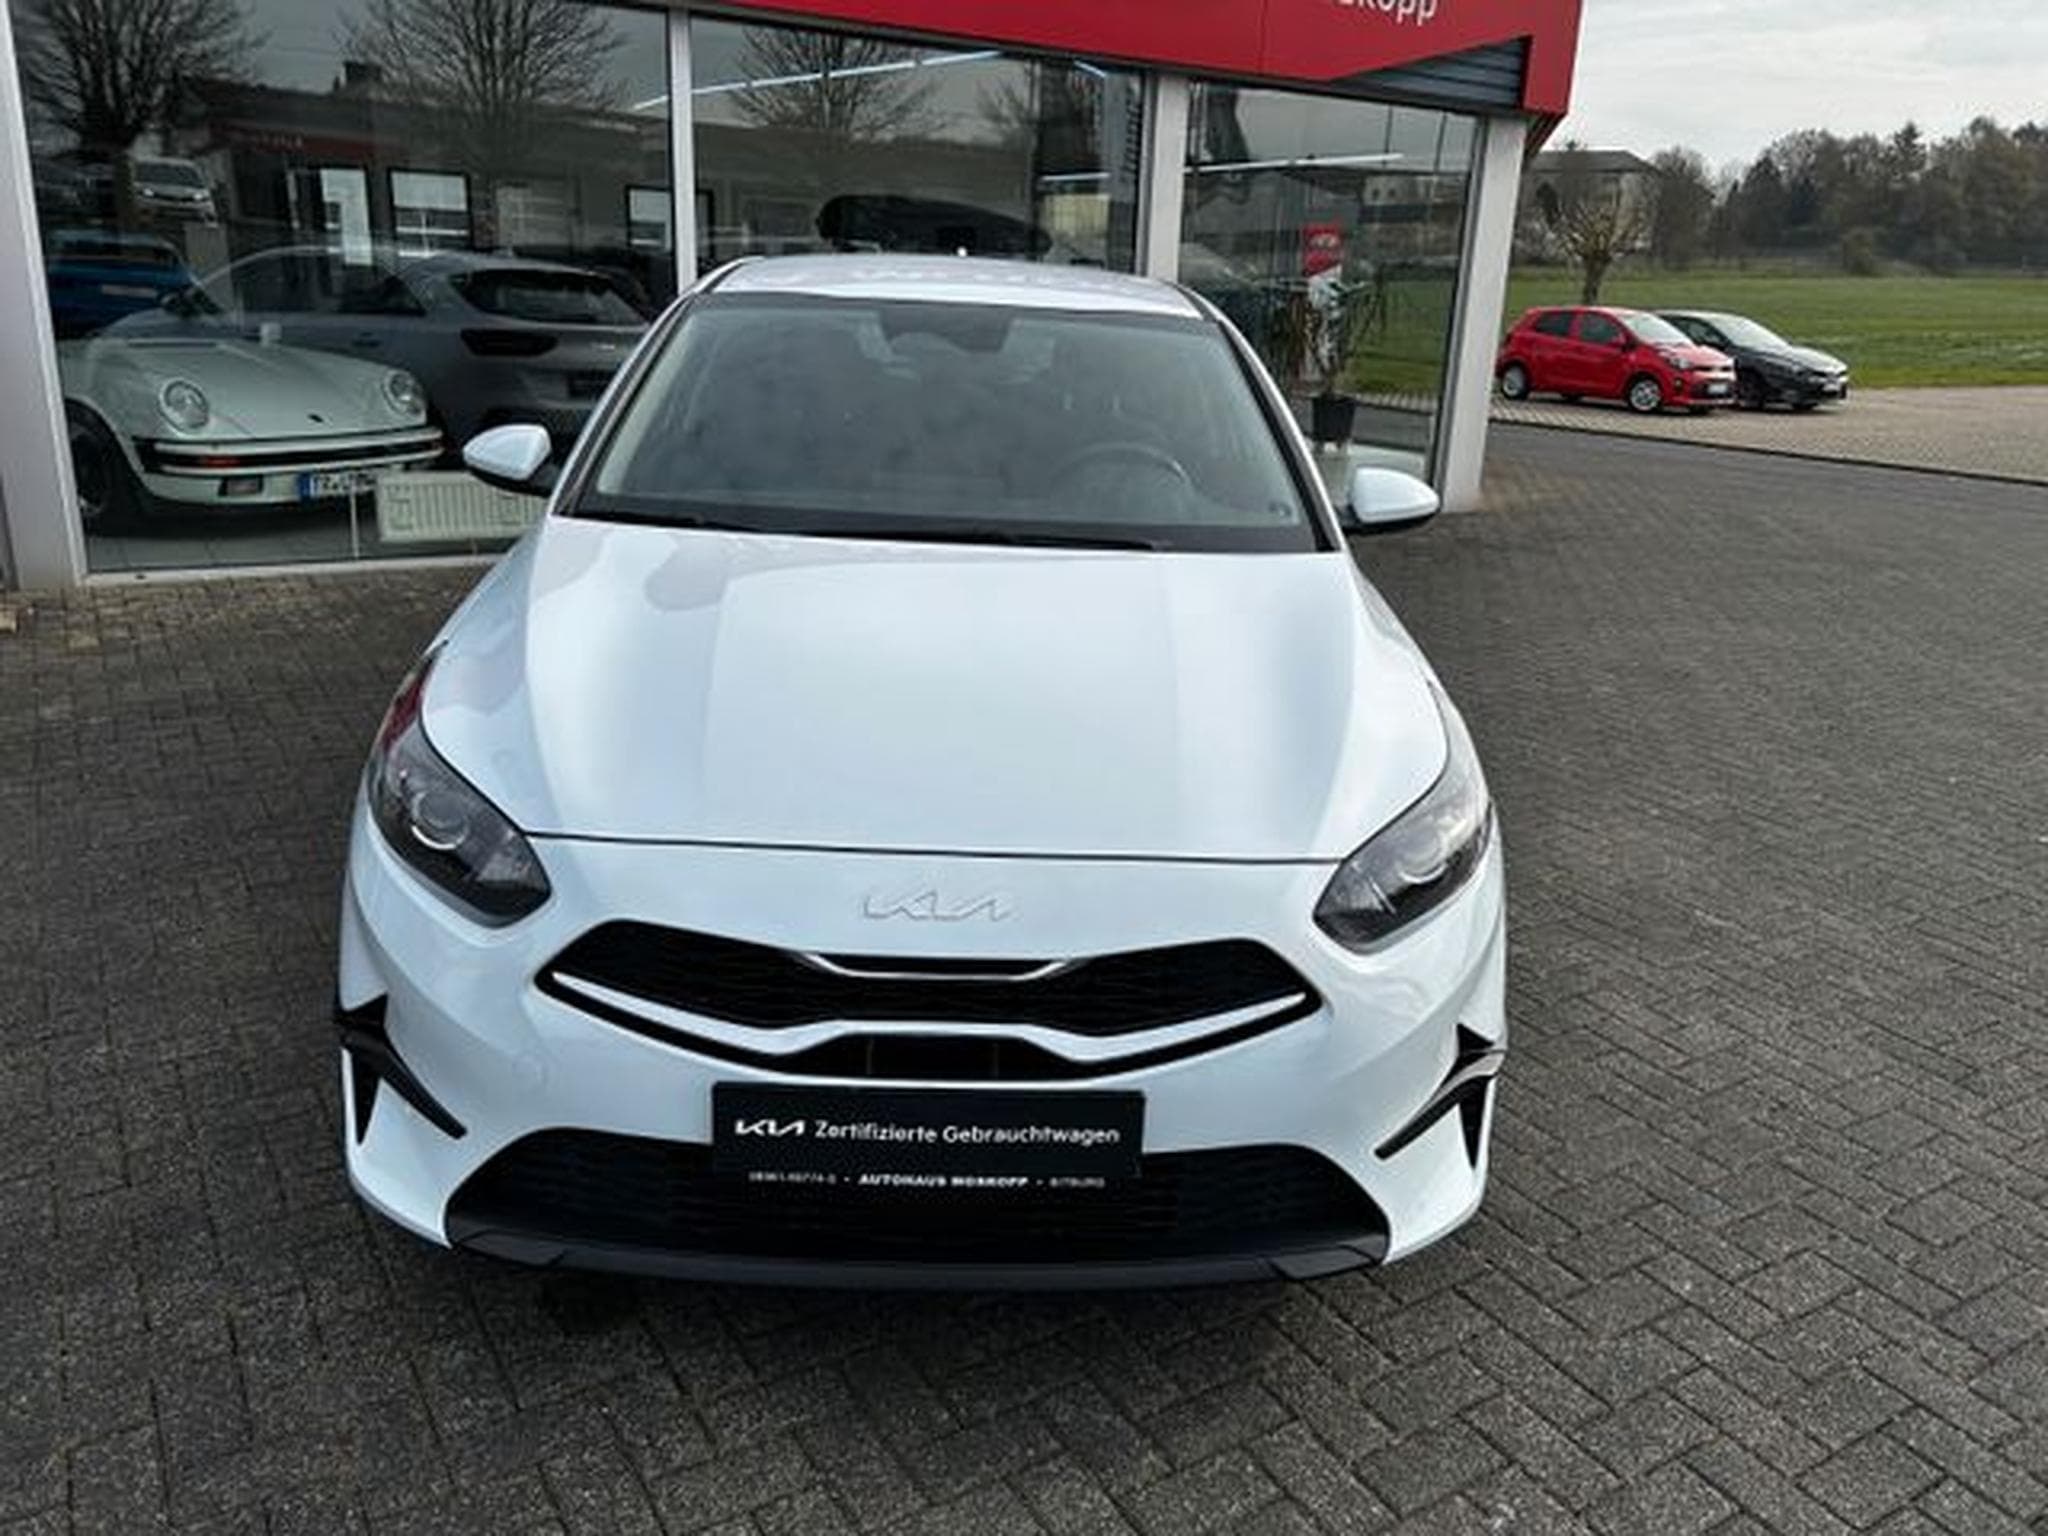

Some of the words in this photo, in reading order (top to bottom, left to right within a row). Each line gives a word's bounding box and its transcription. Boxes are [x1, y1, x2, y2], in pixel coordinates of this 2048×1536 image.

[1334, 0, 1438, 26] opp
[735, 1119, 806, 1137] KIA
[815, 1119, 938, 1142] Zertifizierte
[942, 1125, 1121, 1148] Gebrauchtwagen
[858, 1173, 947, 1187] AUTOHAUS
